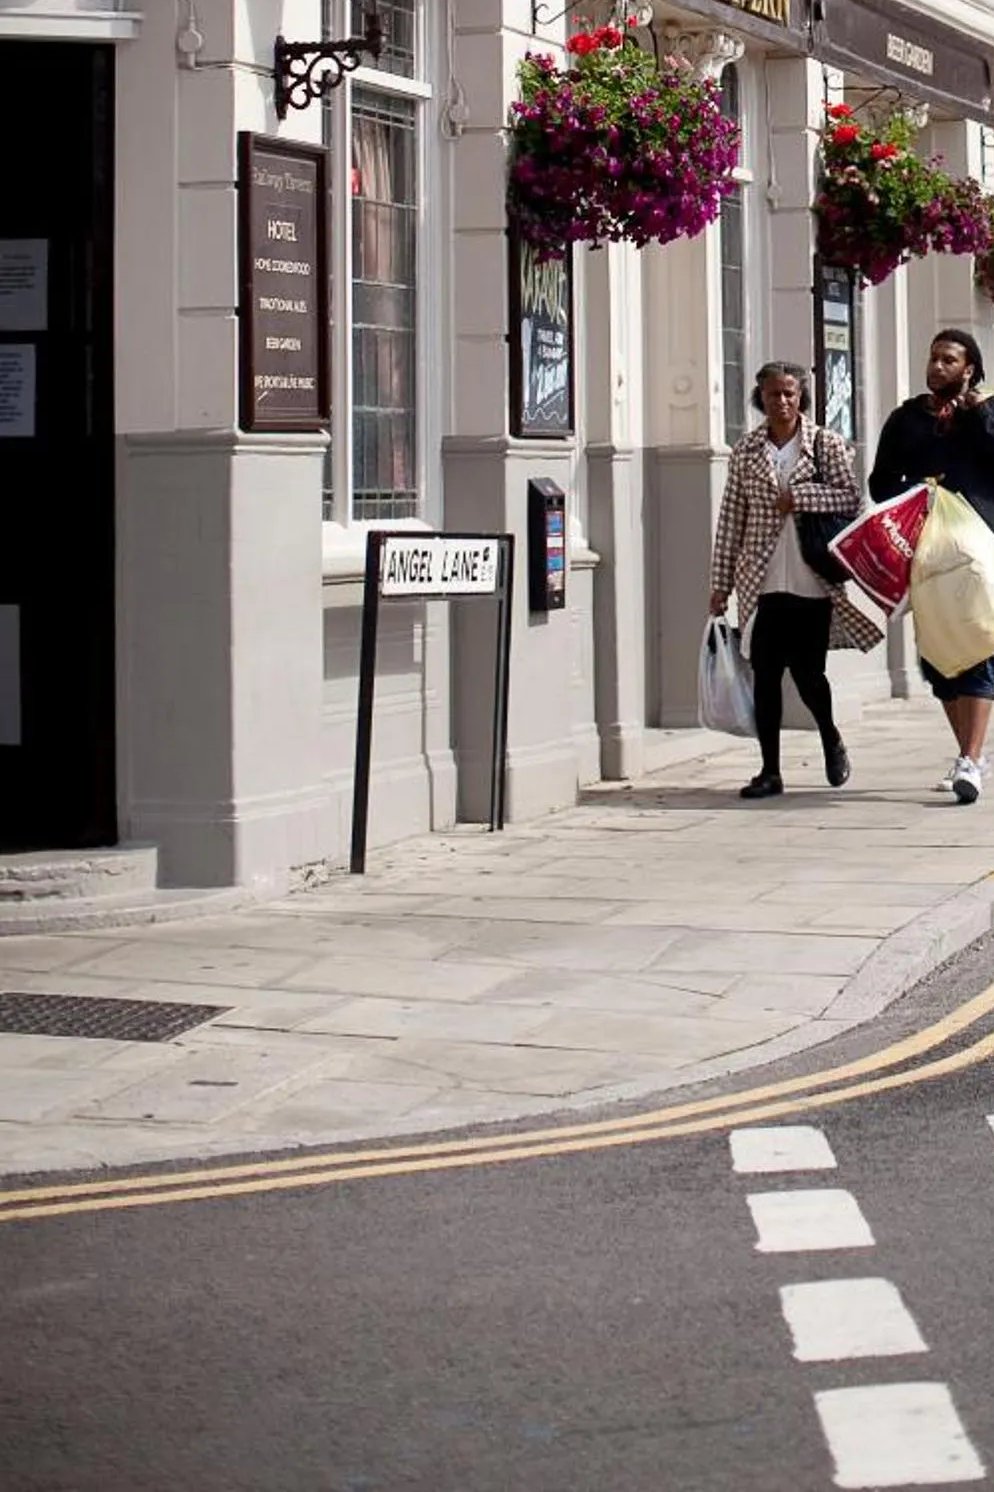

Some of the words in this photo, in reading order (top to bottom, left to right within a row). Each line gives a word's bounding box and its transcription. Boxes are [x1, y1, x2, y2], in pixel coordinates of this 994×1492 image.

[267, 219, 298, 242] HOTEL
[386, 549, 433, 583] ANGEL
[441, 550, 480, 582] LANE
